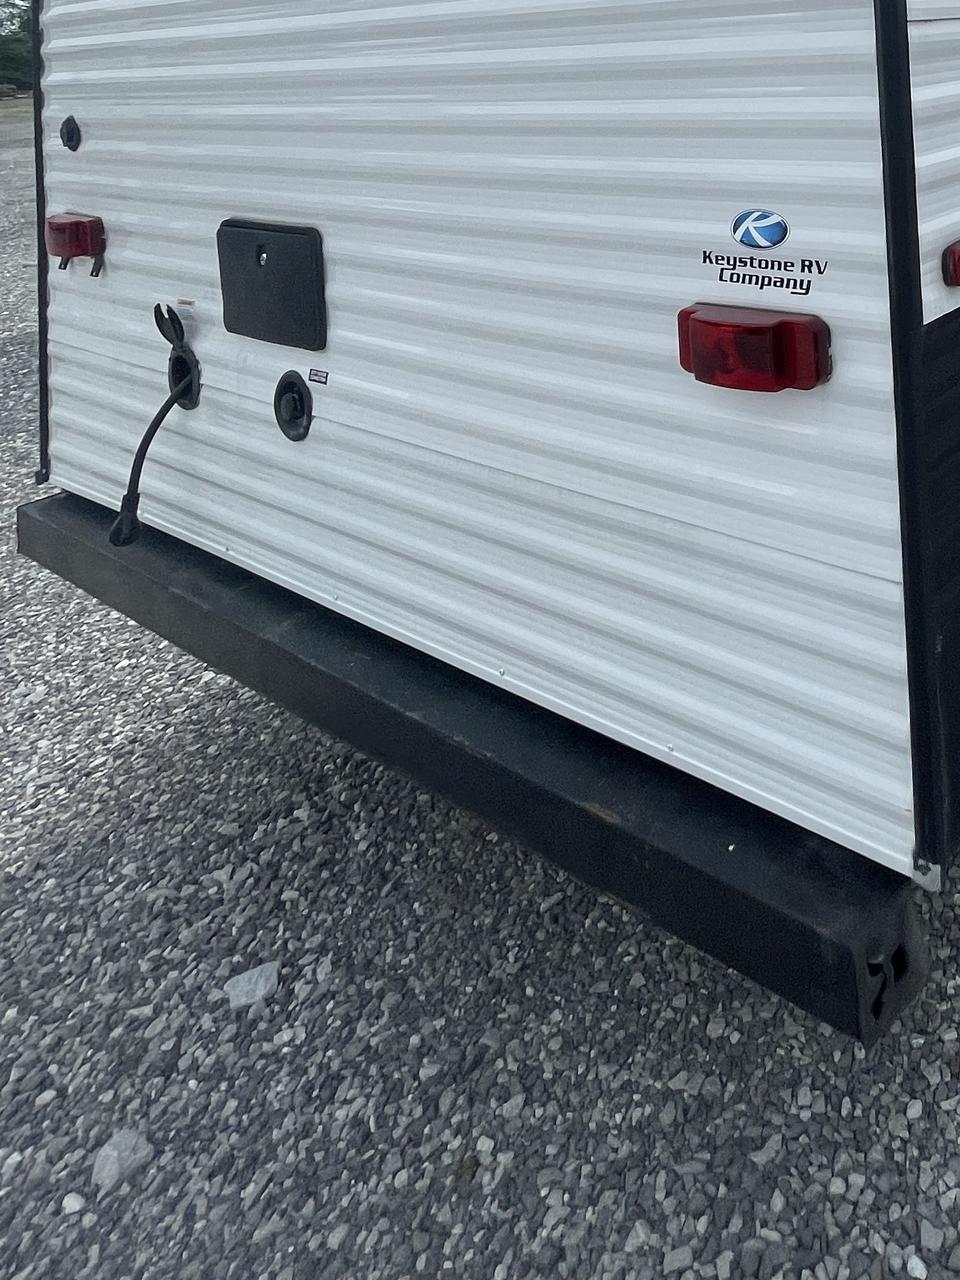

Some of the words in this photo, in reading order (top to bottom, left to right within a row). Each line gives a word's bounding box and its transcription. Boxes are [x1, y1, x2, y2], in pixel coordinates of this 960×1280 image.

[702, 250, 795, 272] Keystone
[800, 259, 828, 275] RV
[718, 268, 812, 295] Company
